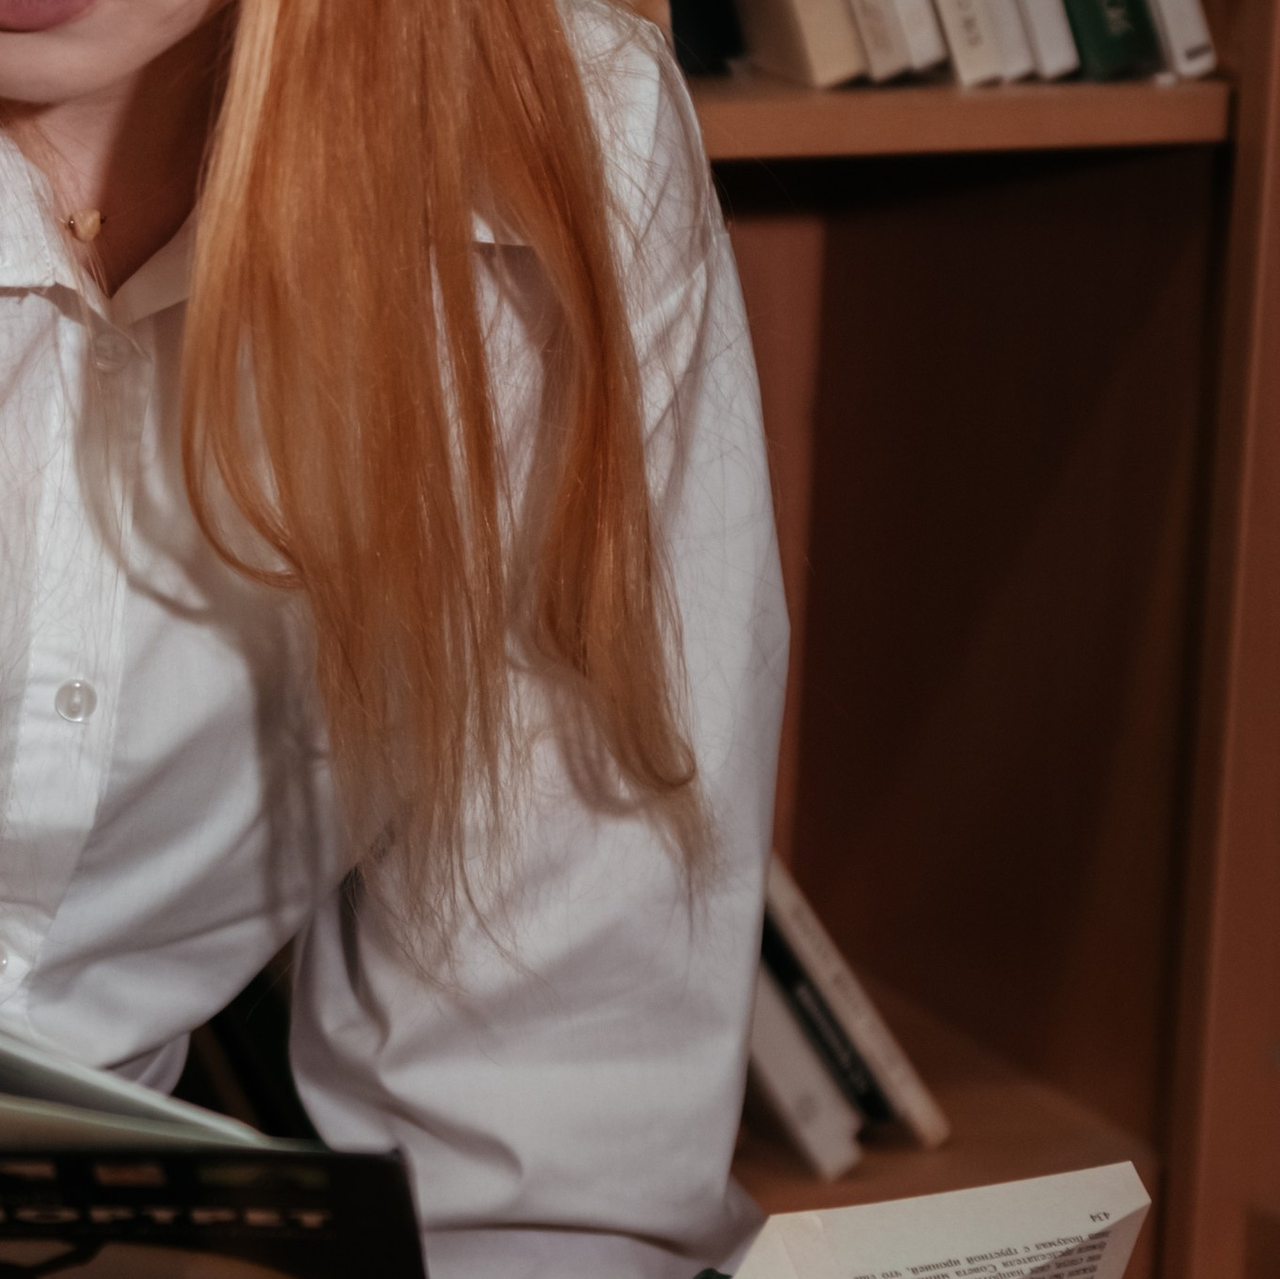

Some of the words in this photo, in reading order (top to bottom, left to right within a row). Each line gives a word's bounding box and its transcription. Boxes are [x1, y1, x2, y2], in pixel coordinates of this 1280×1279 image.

[1090, 1212, 1110, 1222] 434
[1035, 1236, 1084, 1250] подумал
[966, 1247, 1018, 1265] грустной
[906, 1258, 961, 1275] иронией,
[955, 1264, 997, 1276] Совета
[881, 1270, 902, 1279] что
